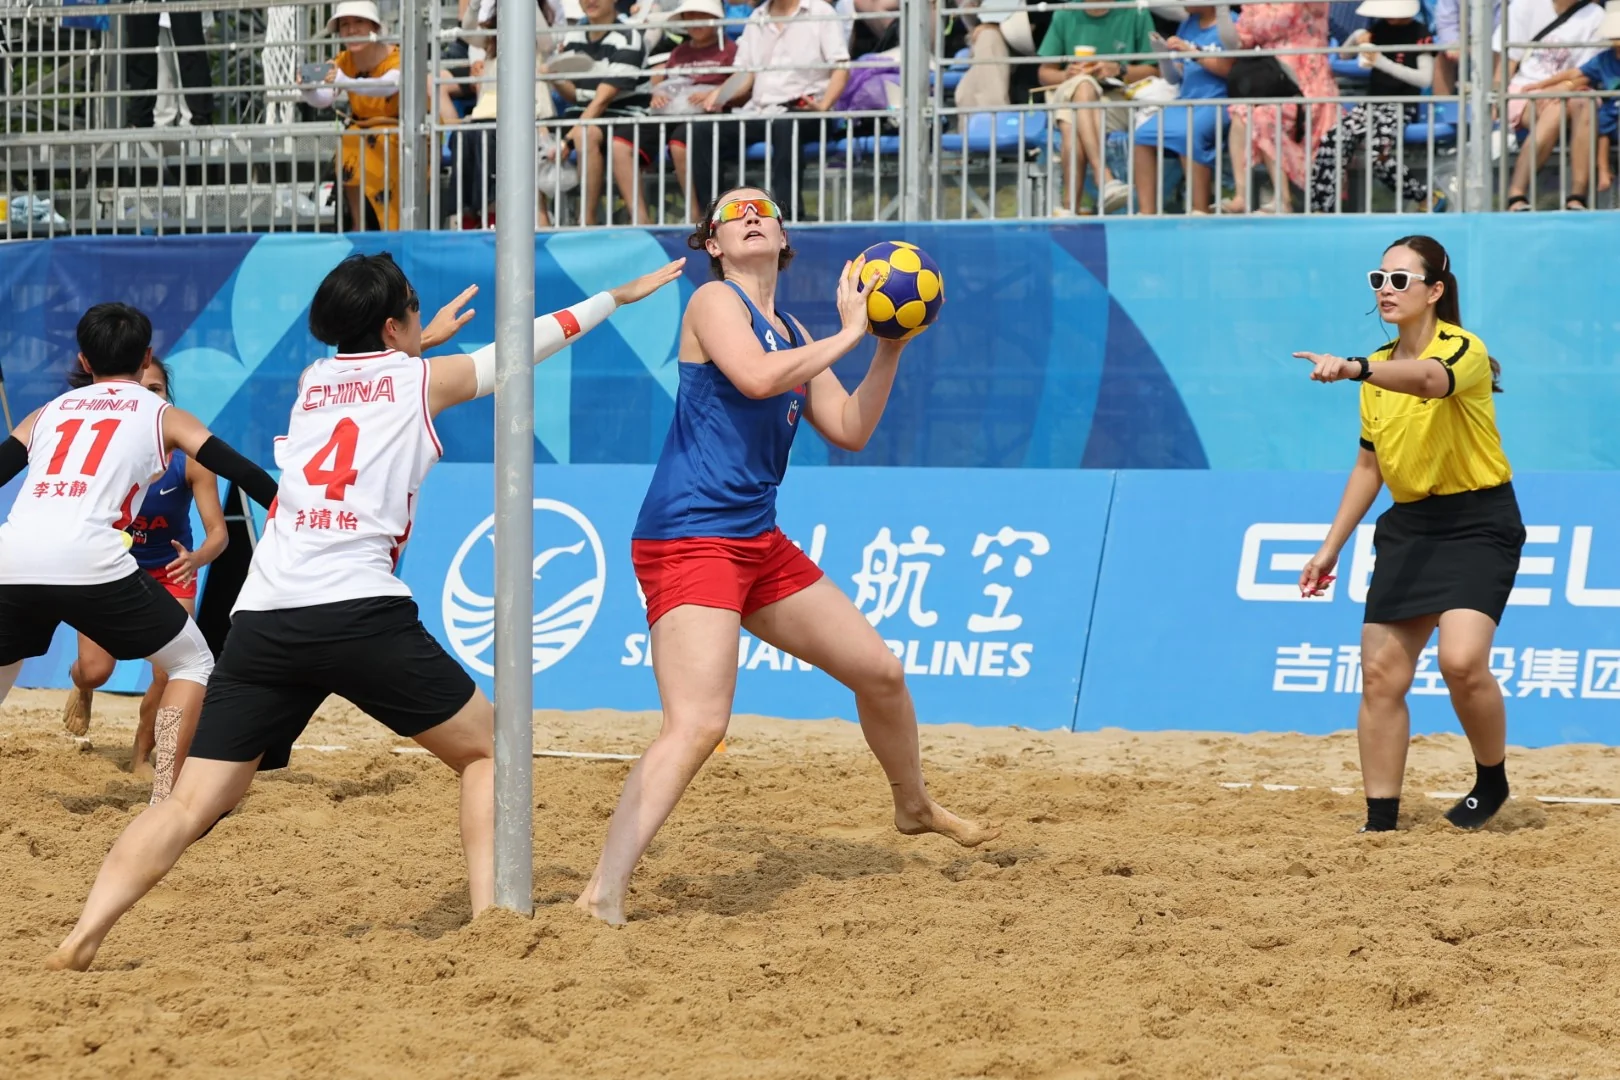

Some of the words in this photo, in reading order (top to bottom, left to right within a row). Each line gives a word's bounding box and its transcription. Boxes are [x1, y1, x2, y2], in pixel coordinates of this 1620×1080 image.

[59, 398, 138, 412] CHINA
[302, 376, 395, 411] CHINA
[46, 418, 121, 476] 11
[303, 416, 360, 501] 4
[33, 480, 88, 498] 李文静
[131, 516, 168, 530] SA
[883, 639, 1033, 677] LINES
